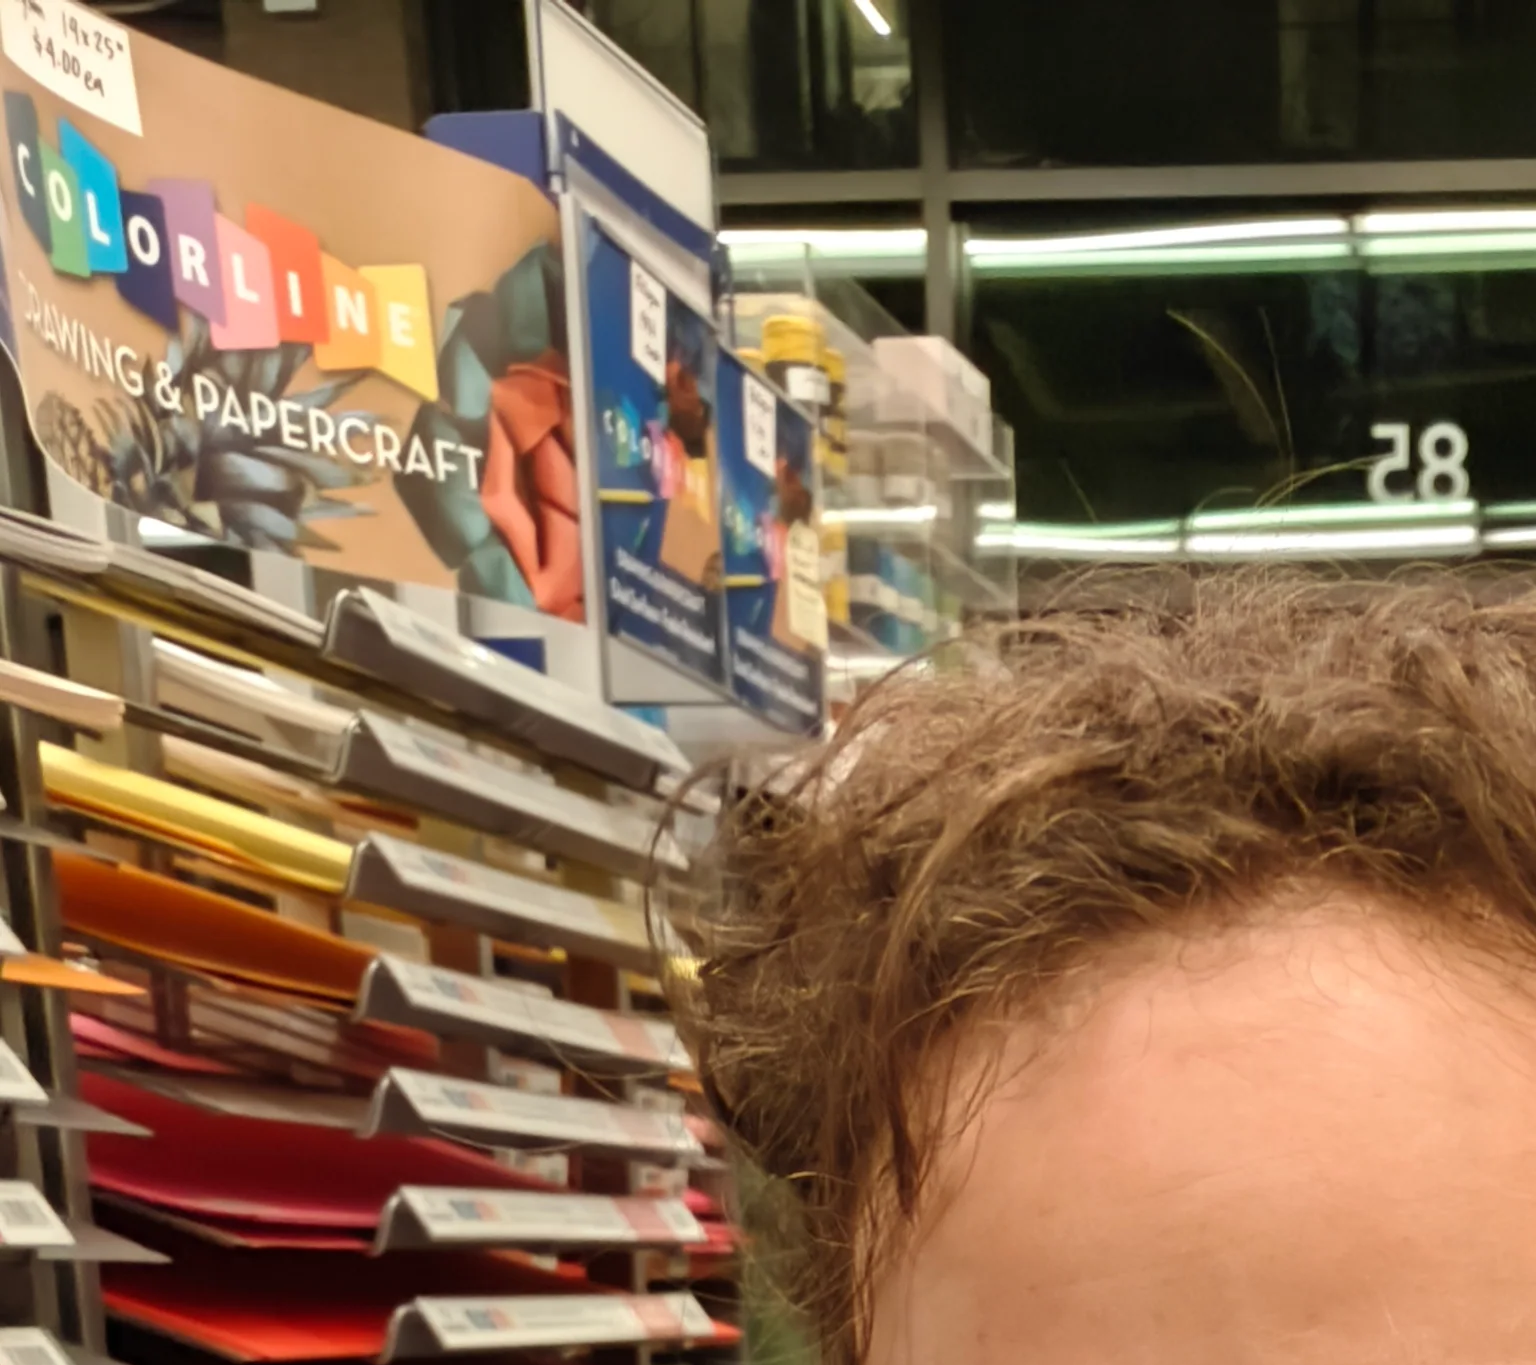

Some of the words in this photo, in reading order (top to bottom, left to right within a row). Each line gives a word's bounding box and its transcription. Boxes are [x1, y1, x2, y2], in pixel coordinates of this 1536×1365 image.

[16, 142, 417, 348] COLORLINE
[154, 360, 184, 415] &
[193, 374, 484, 490] PAPERCRAFT
